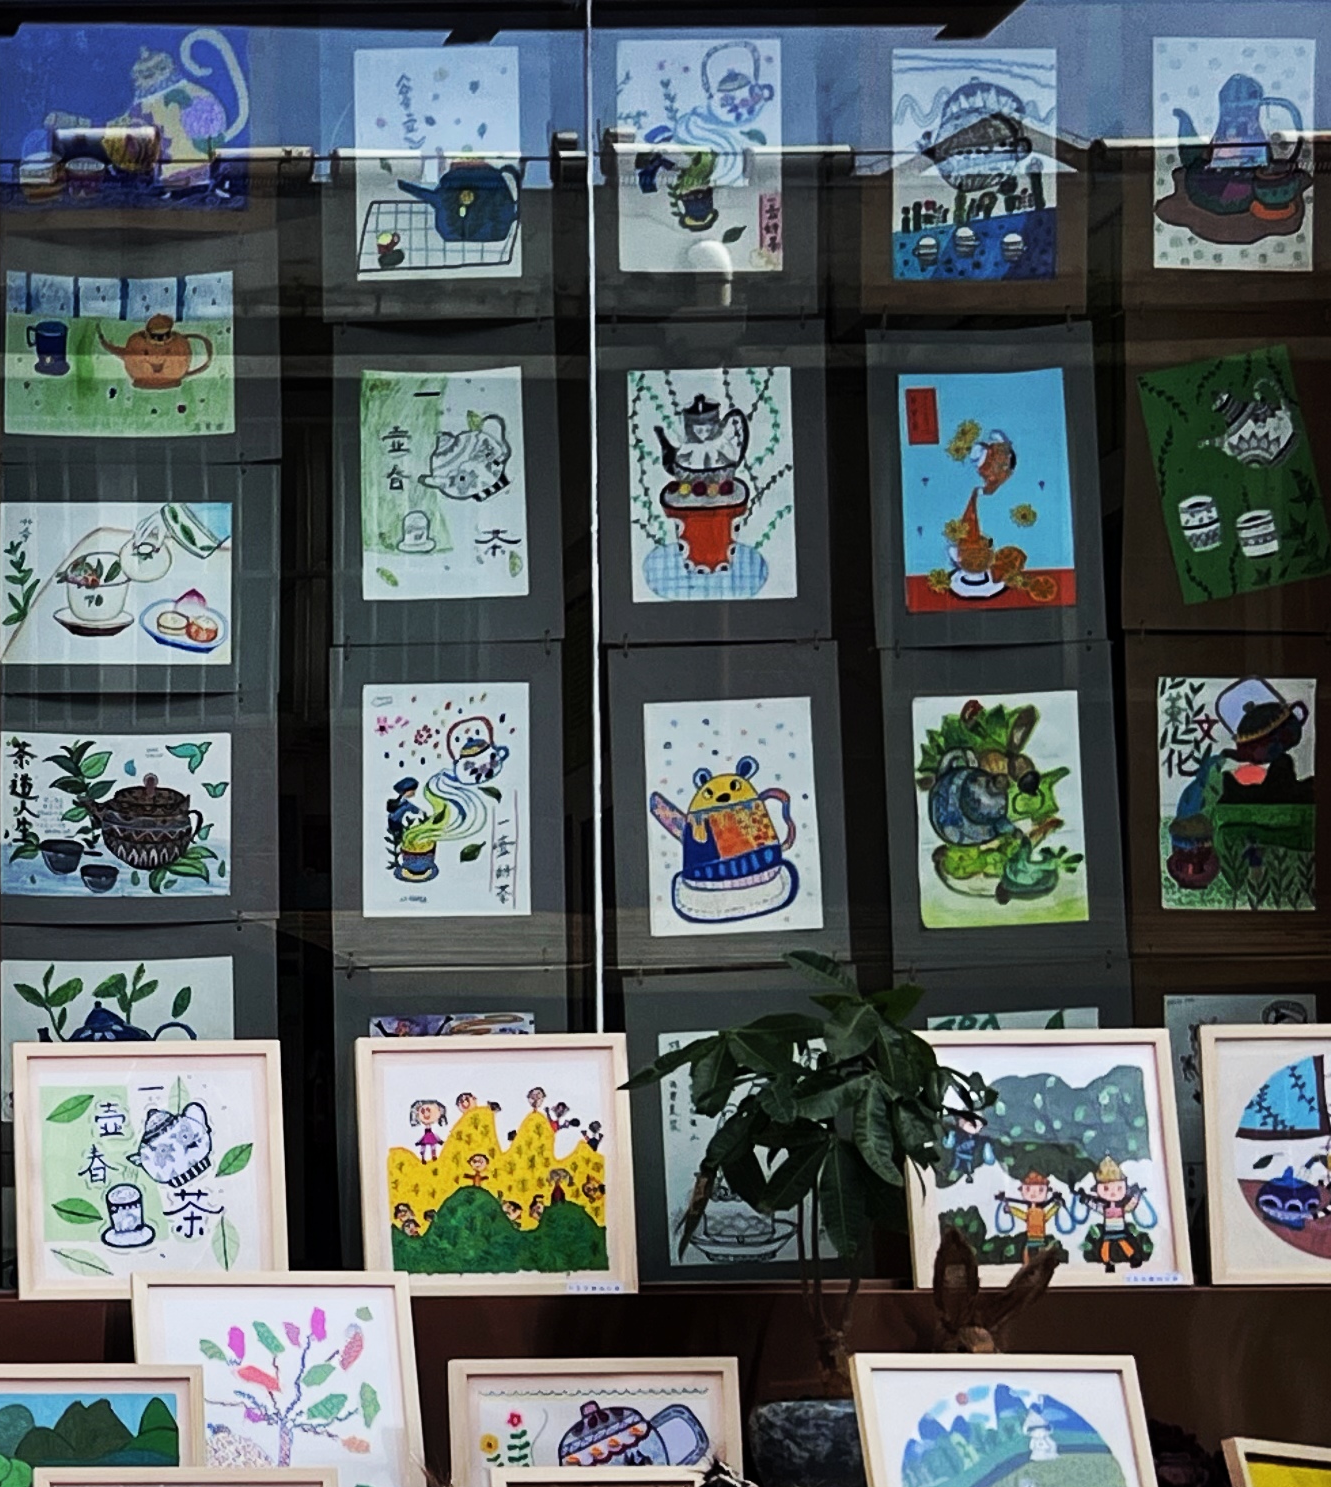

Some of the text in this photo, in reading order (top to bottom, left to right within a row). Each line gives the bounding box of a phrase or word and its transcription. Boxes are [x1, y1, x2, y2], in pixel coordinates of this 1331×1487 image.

[6, 741, 40, 843] 茶道人生
[163, 1188, 225, 1239] 茶
